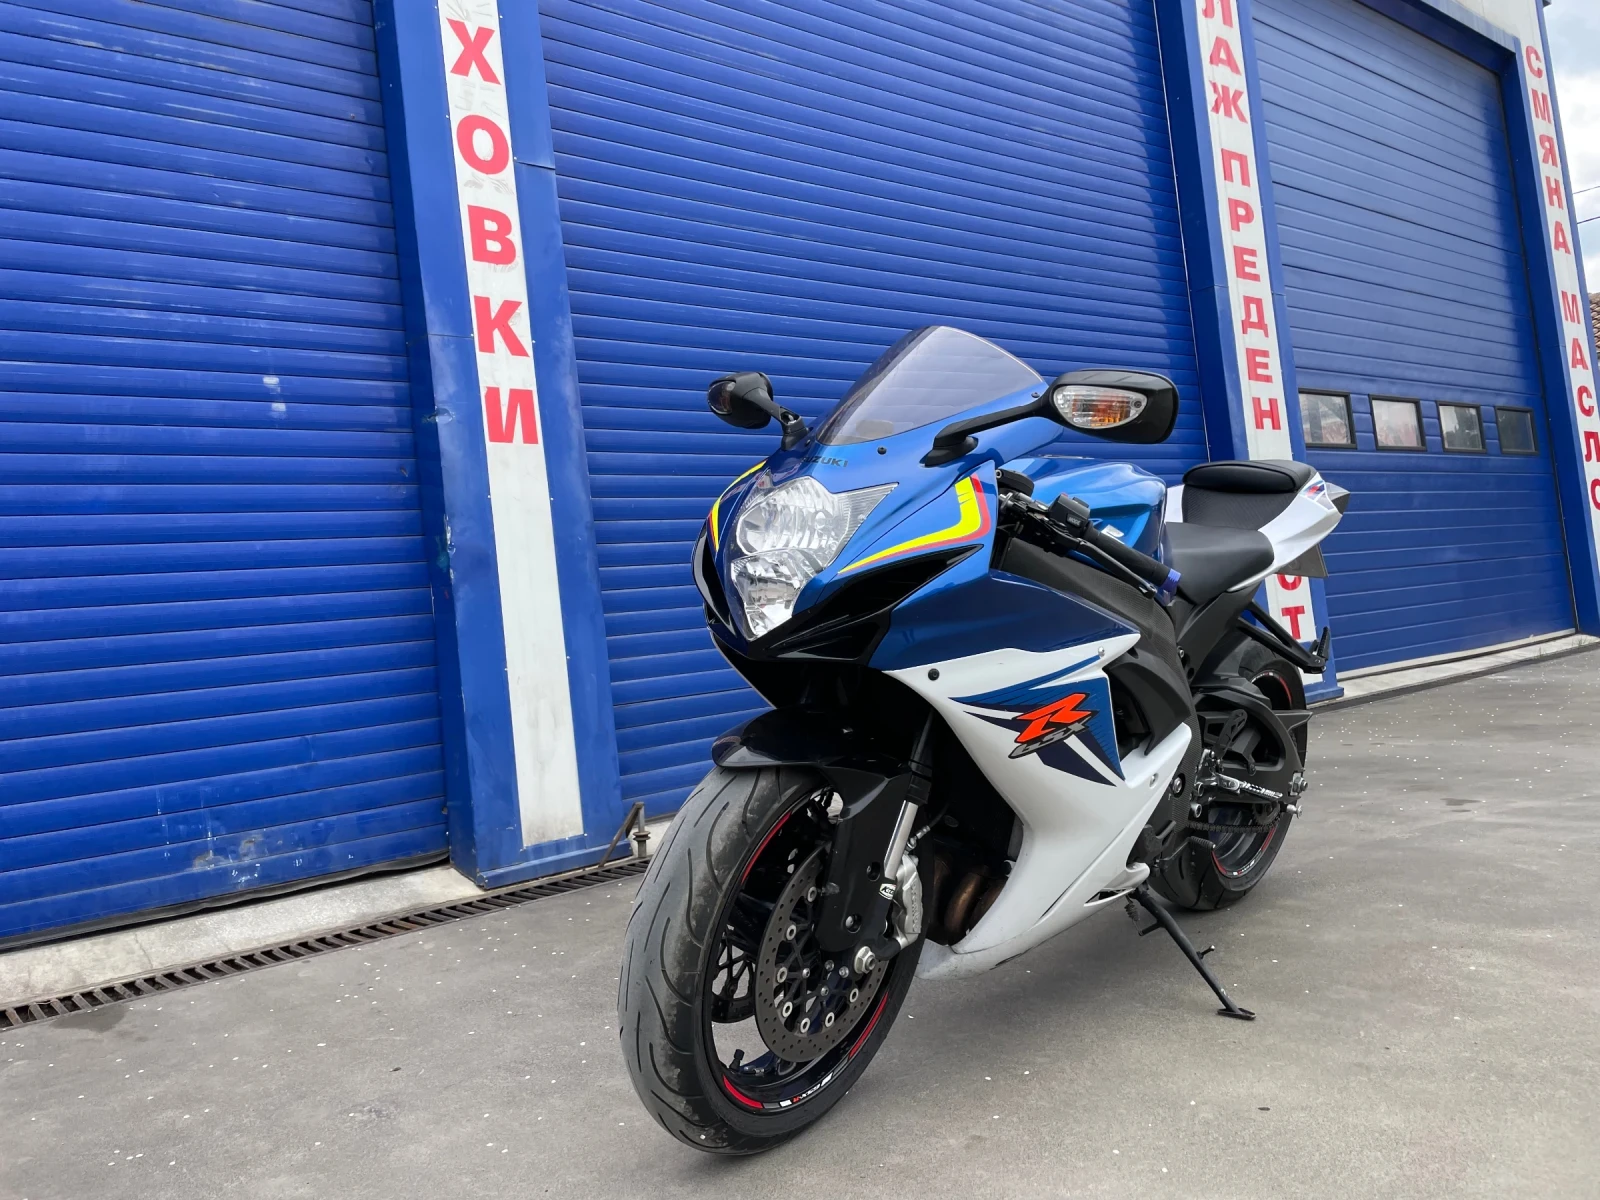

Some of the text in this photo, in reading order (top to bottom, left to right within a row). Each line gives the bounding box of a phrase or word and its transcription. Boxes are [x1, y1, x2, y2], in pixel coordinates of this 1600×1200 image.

[447, 17, 539, 445] ХОВКИ
[1221, 148, 1281, 431] ПРЕДЕН
[1525, 45, 1571, 255] СМЯНА
